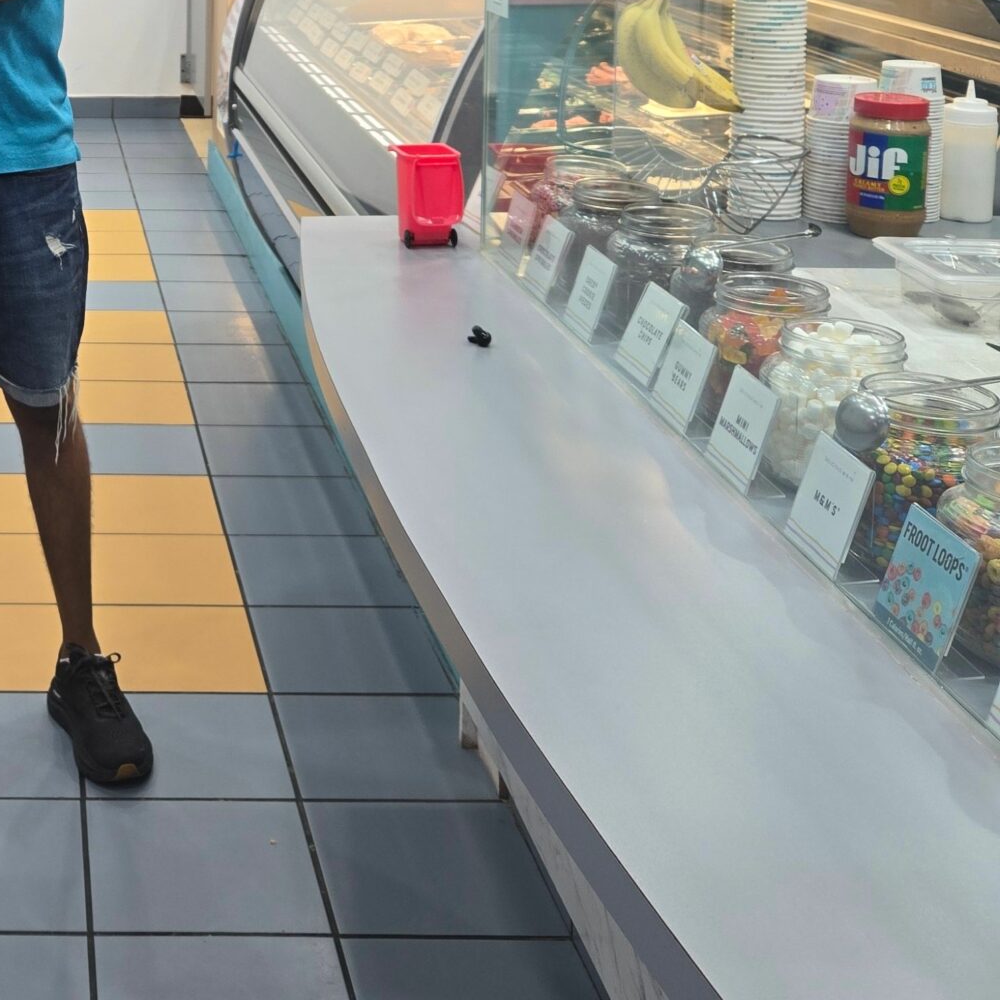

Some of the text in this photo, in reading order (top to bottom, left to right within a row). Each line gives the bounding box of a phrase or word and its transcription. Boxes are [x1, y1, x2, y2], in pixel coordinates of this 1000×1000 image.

[849, 144, 909, 181] Jif
[637, 316, 664, 341] CHOCOLATE
[637, 330, 653, 346] CHIPS
[671, 371, 687, 392] BEARS
[674, 361, 692, 381] GUMMY
[736, 414, 750, 430] MINI
[719, 415, 758, 456] MARSHMALLOWS
[903, 521, 936, 556] FROOT
